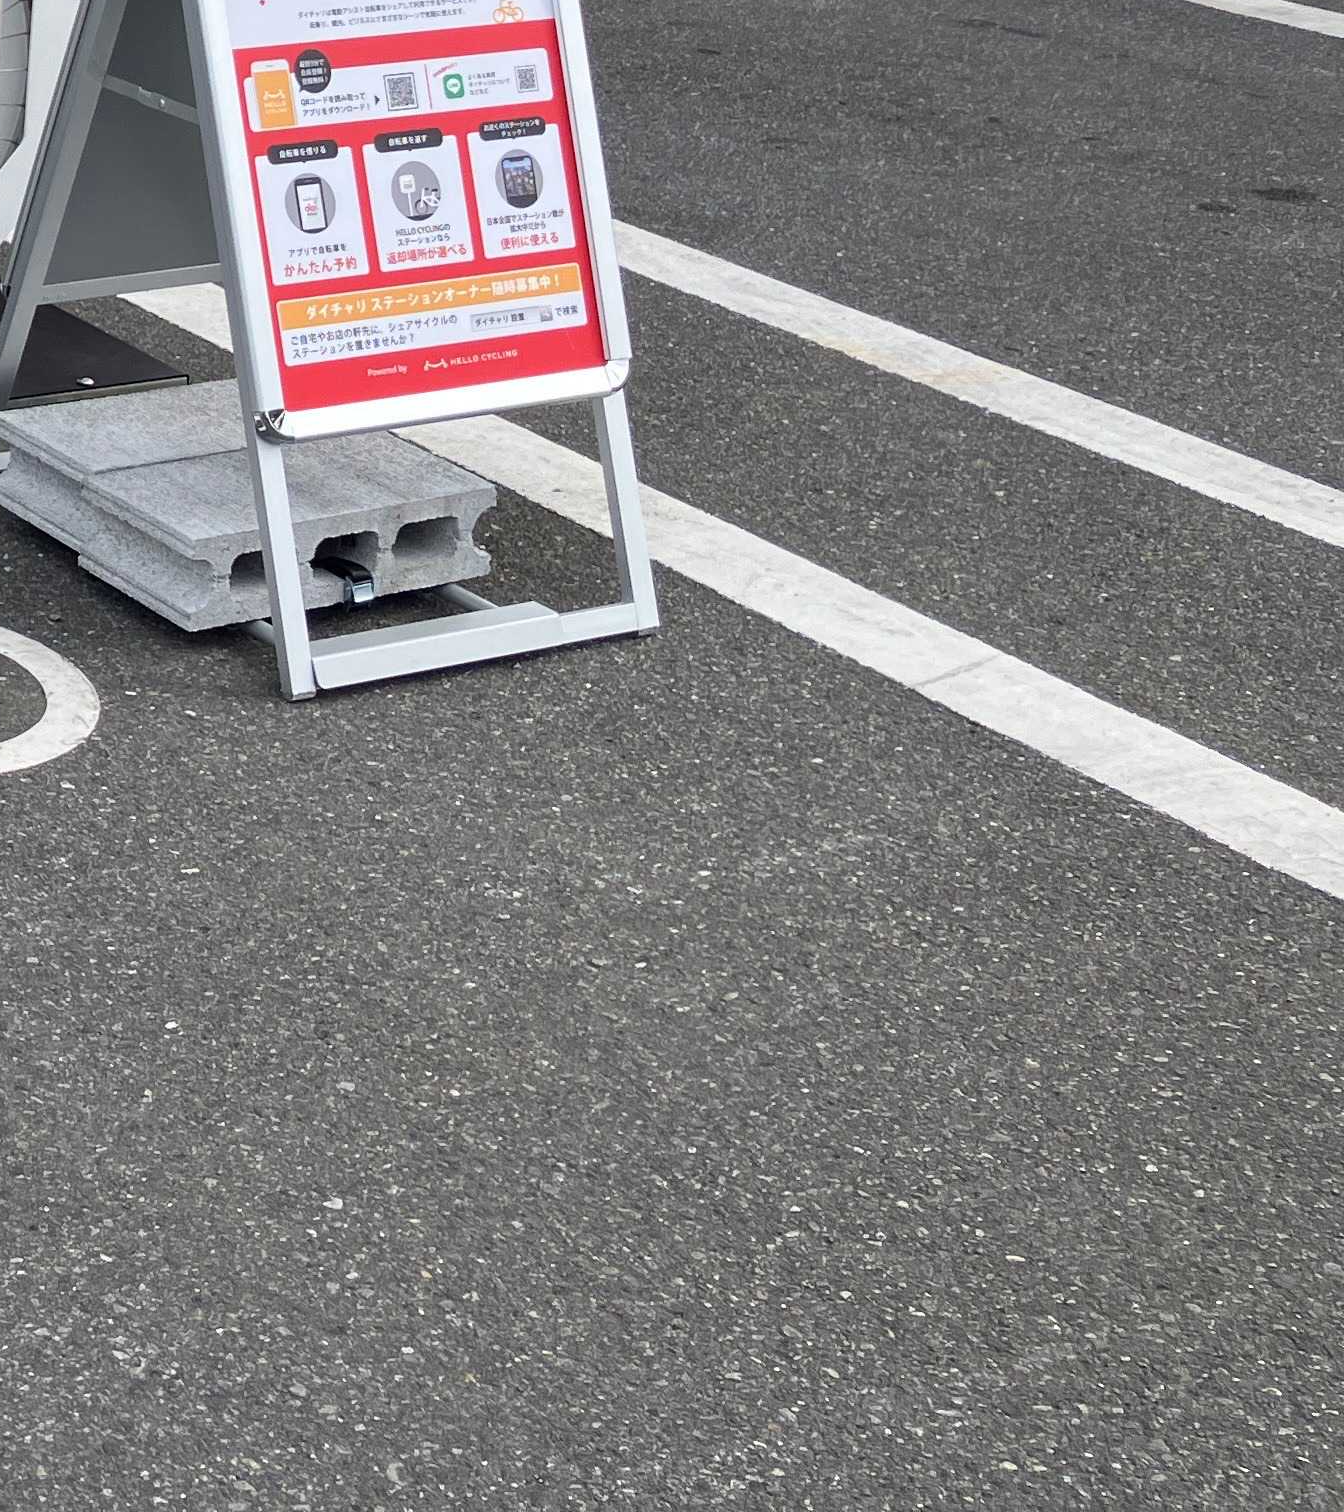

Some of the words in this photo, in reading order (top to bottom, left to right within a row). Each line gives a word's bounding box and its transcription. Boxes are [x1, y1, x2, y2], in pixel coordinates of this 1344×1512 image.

[279, 145, 327, 159] 自転車を借りる
[397, 233, 450, 247] ステーションなら
[501, 232, 560, 250] 便利に使える
[288, 243, 347, 258] アプリで自転車を
[387, 244, 467, 264] 返却場所が選べる
[283, 256, 358, 278] かんたん予約
[305, 299, 367, 320] ダイチャリ
[554, 304, 579, 317] で検索
[474, 314, 509, 328] ダイチャリ
[450, 354, 479, 366] HELLO
[480, 349, 518, 362] CYCLING
[367, 365, 395, 377] Powered
[396, 364, 408, 376] by
